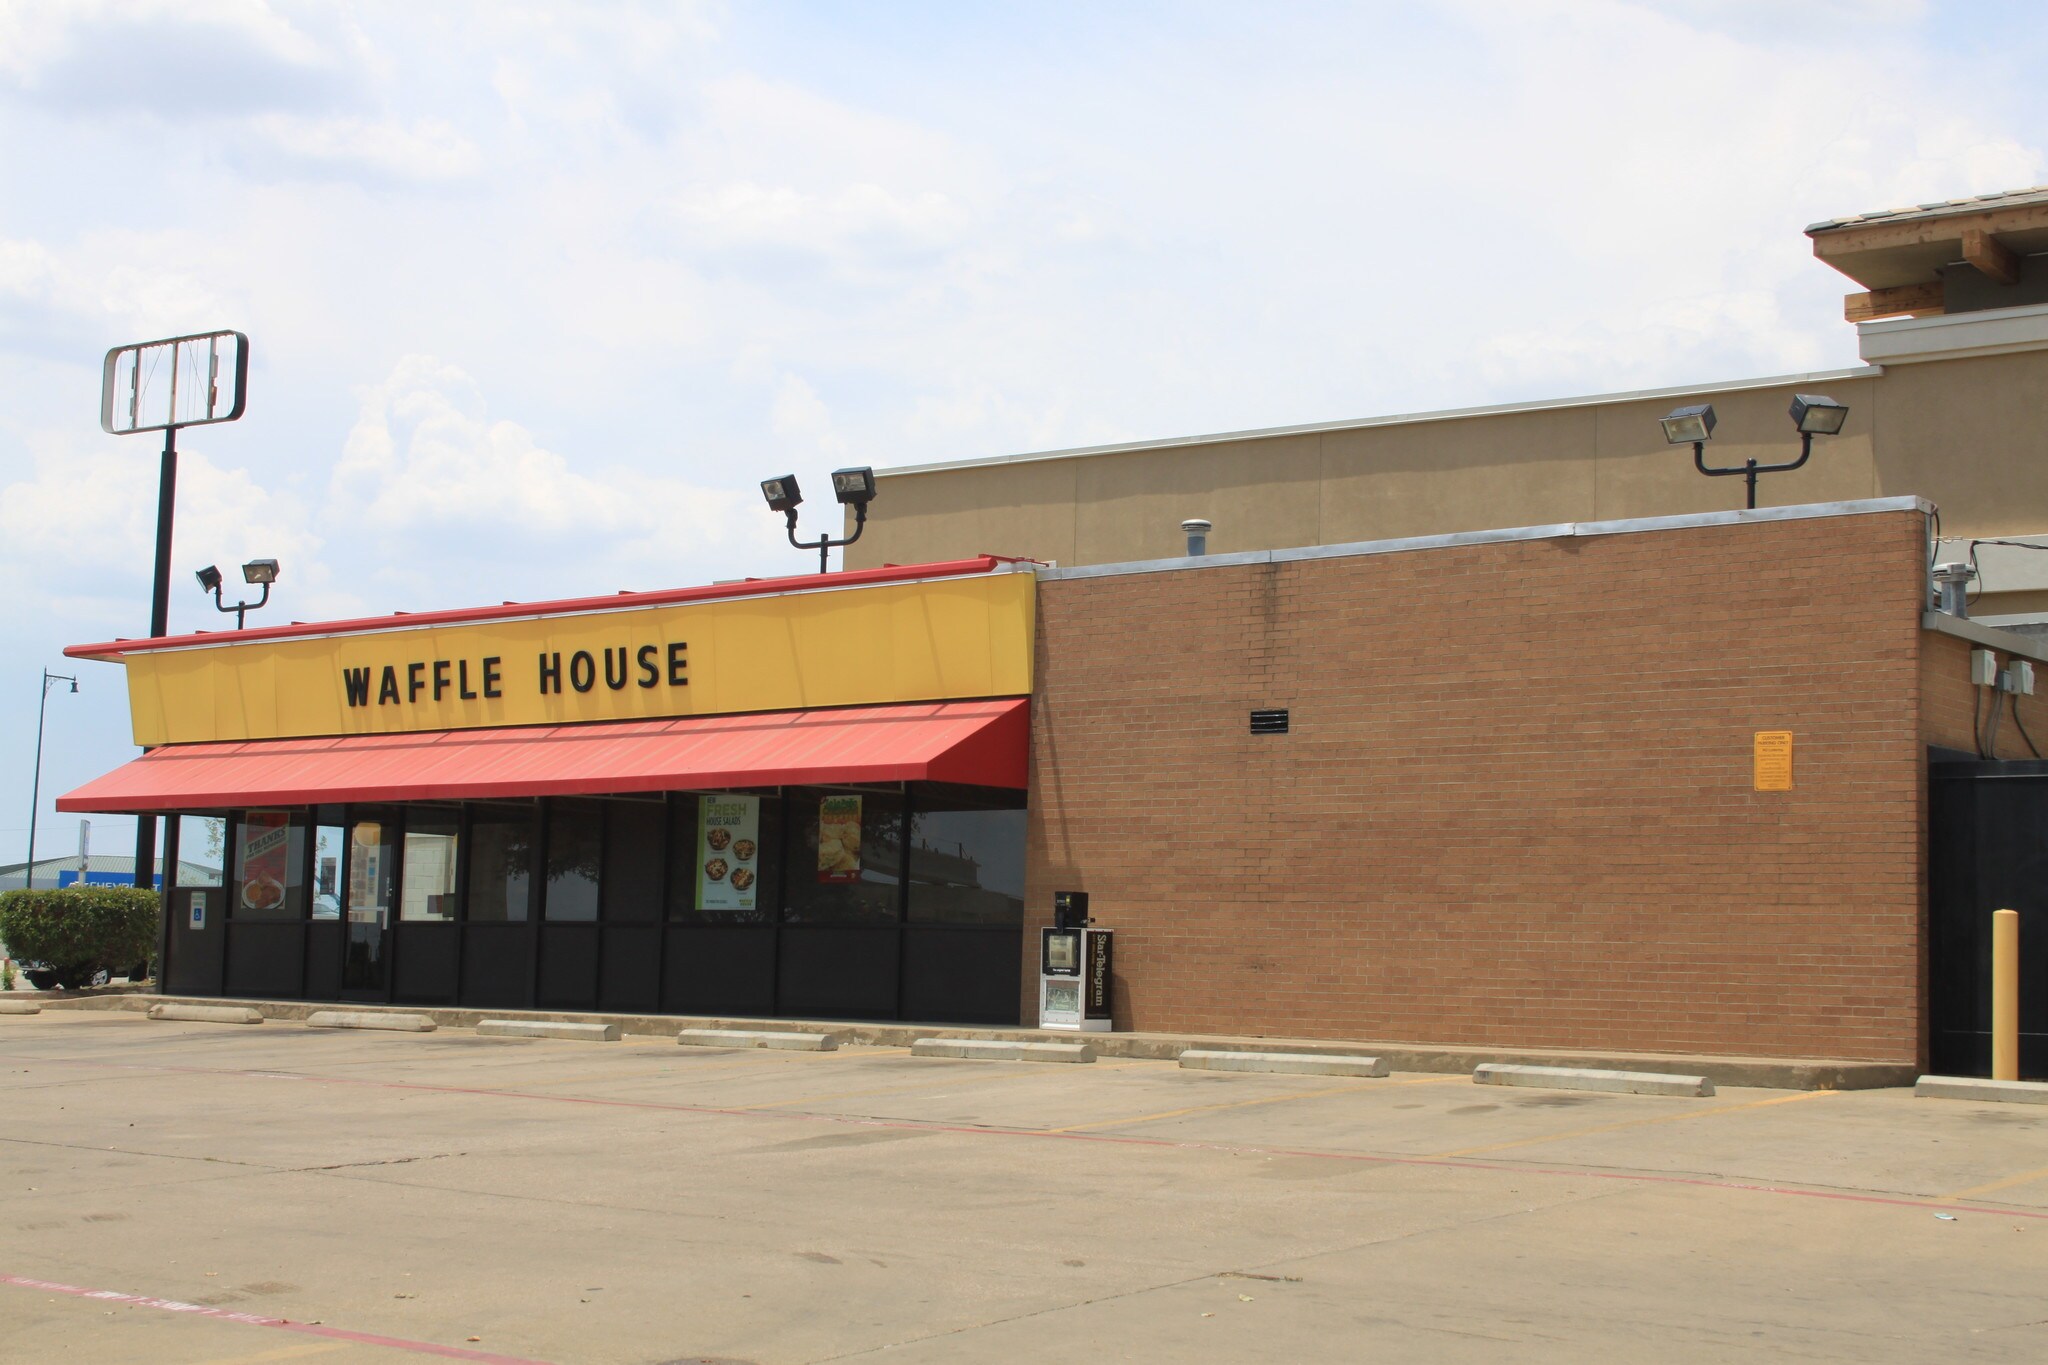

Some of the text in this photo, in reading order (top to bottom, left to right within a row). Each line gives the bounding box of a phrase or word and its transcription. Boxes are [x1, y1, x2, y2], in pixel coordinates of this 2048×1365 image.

[343, 642, 688, 707] WAFFLE HOUSE
[706, 815, 741, 826] HOUSE SALADS
[707, 803, 747, 816] FRESH
[247, 826, 286, 853] THANKS
[1094, 934, 1107, 1007] Star-Telegram
